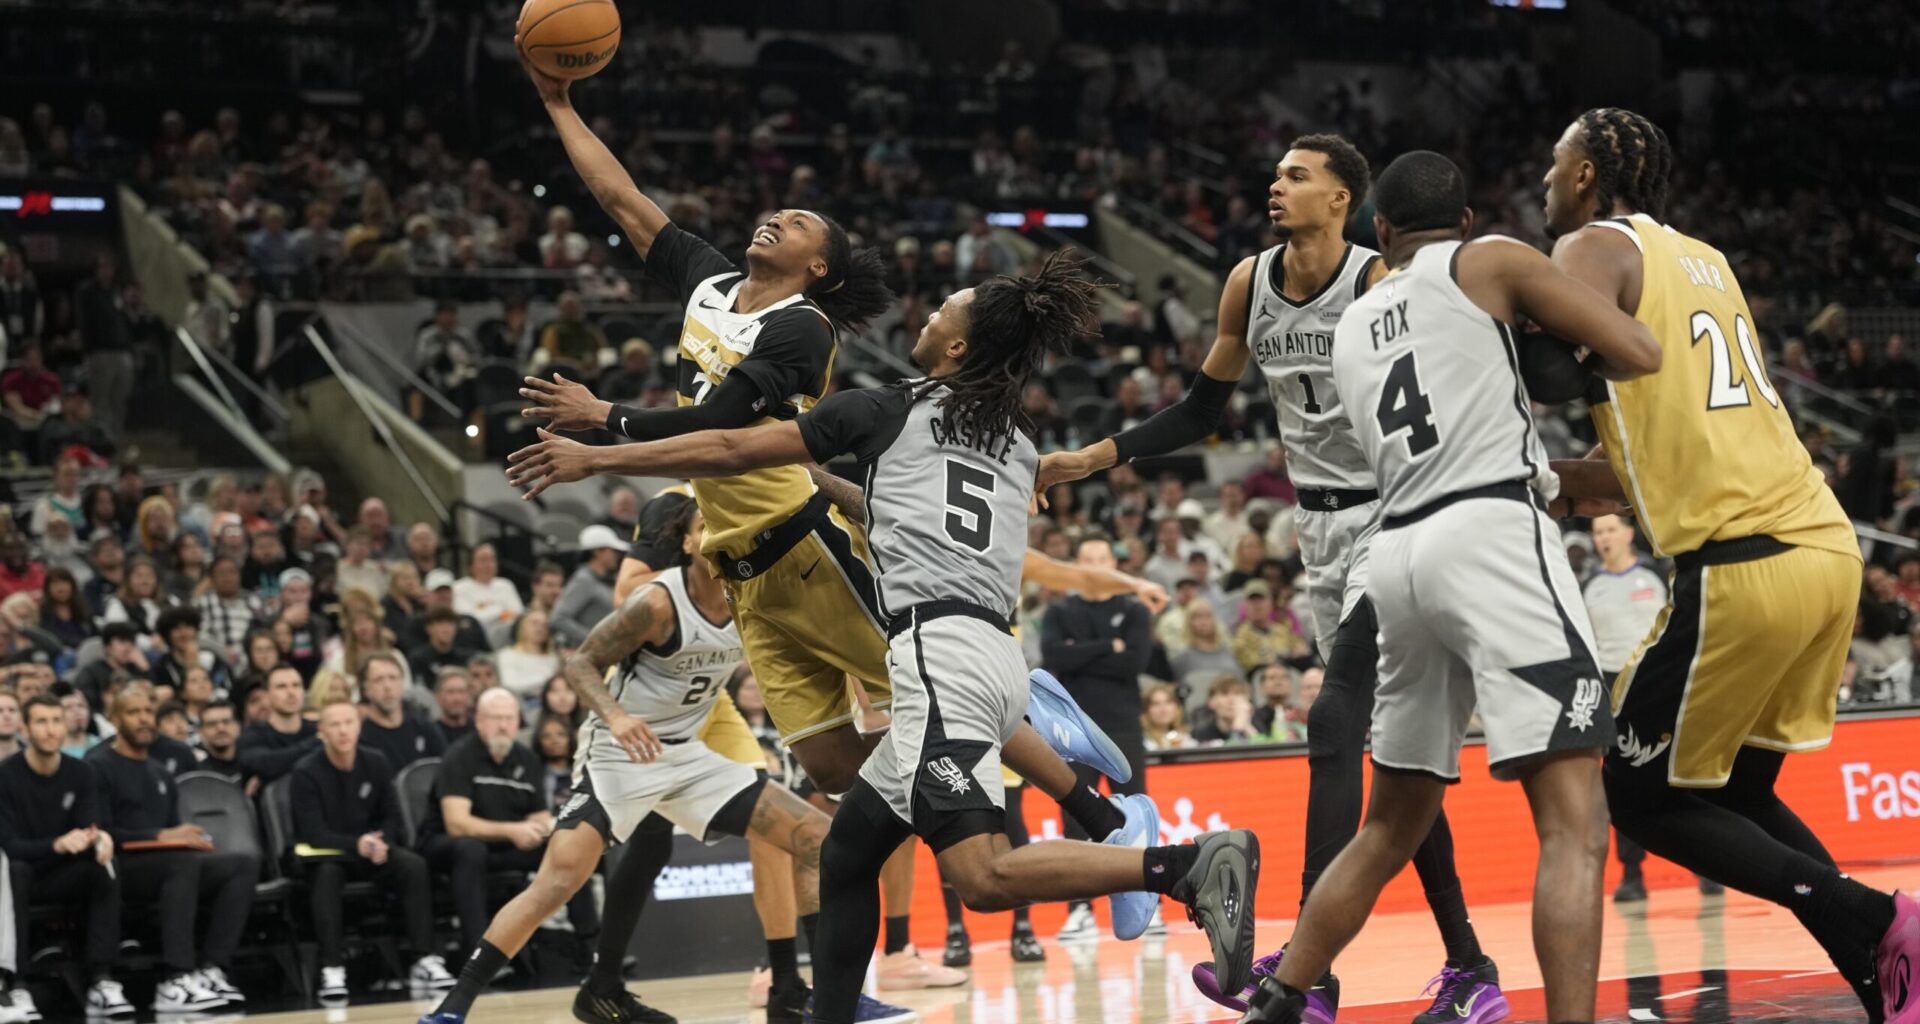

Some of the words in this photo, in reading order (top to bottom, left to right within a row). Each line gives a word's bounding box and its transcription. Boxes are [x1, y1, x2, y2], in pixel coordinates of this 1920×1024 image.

[555, 44, 616, 68] Wilson
[1256, 335, 1282, 365] SAN
[1370, 300, 1409, 351] FOX
[1690, 310, 1778, 411] 20
[1298, 373, 1321, 414] 1
[1374, 348, 1442, 461] 4
[944, 456, 997, 555] 5
[673, 655, 703, 675] SAN
[1840, 762, 1920, 821] Fas
